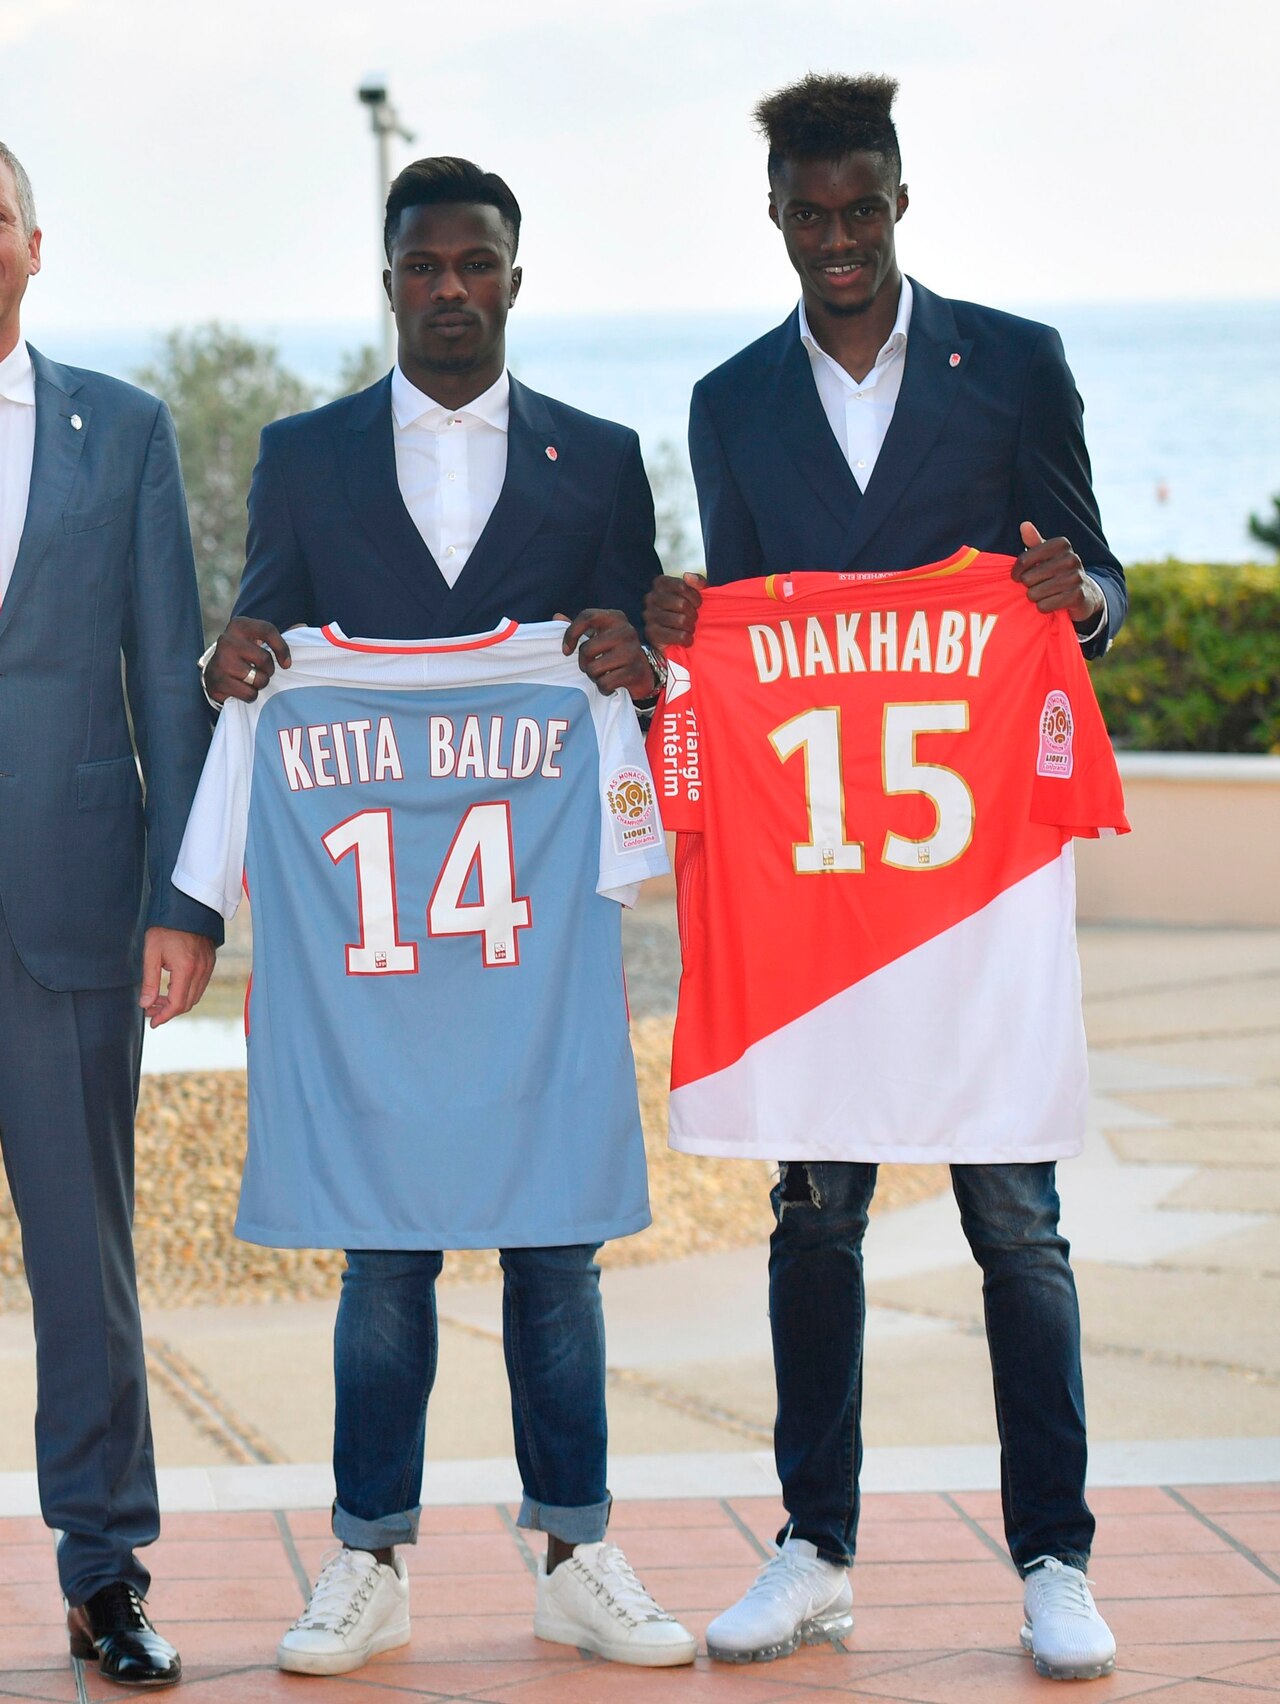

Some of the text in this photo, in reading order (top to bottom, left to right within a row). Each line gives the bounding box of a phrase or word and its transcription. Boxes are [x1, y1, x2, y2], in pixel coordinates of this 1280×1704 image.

[747, 610, 998, 684] DIAKHABY
[278, 715, 570, 792] KEITA BALDE
[609, 771, 646, 790] AS MONACO
[663, 713, 683, 797] intérim
[682, 707, 702, 802] Triangle
[767, 700, 976, 875] 15
[616, 815, 643, 826] CHAMPION
[623, 836, 655, 848] Conforama
[321, 800, 532, 976] 14
